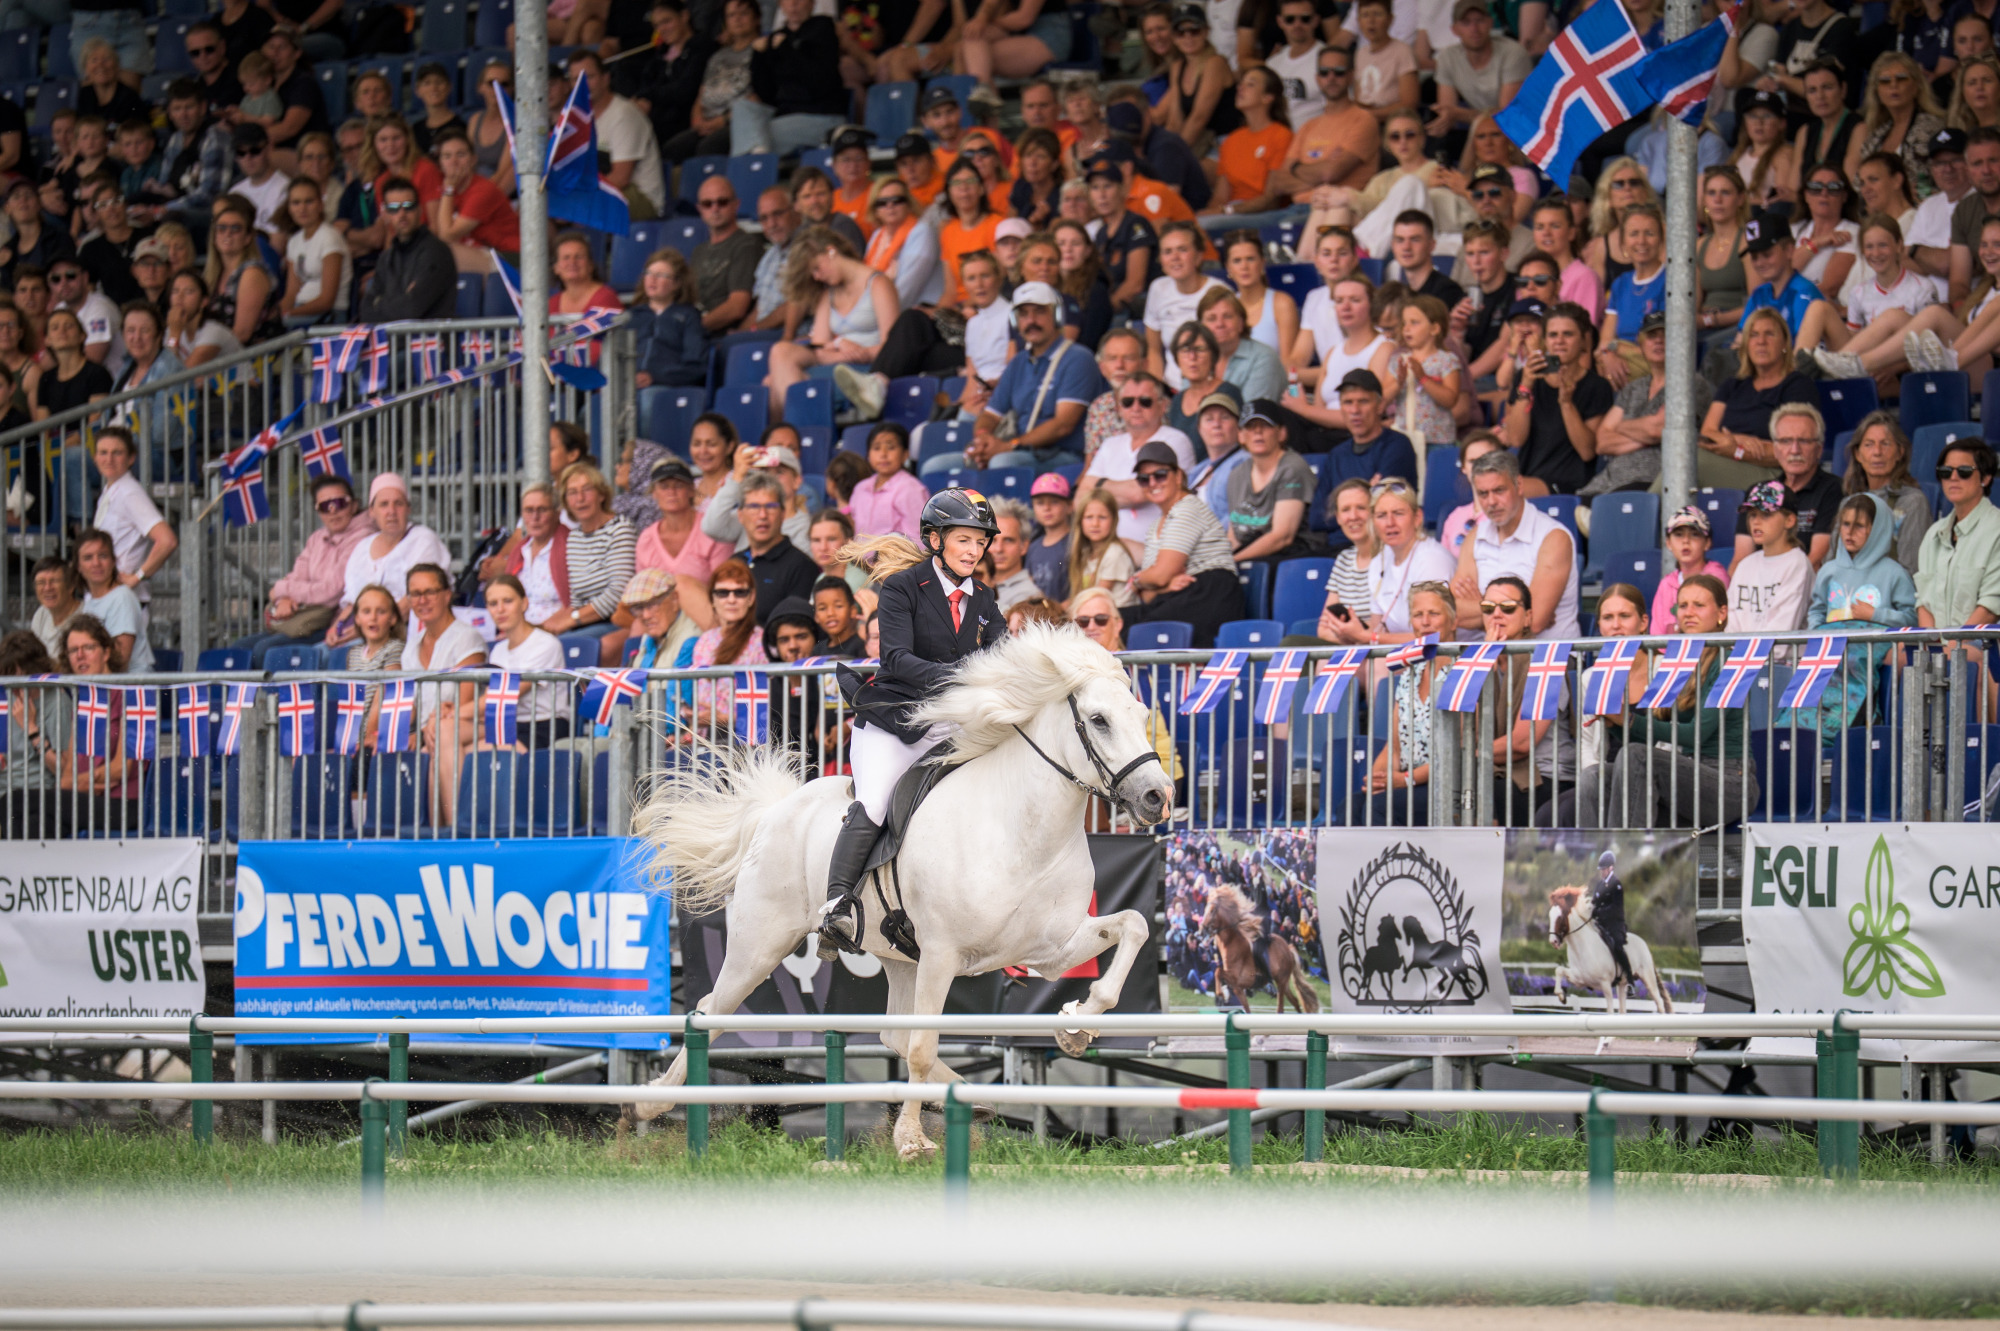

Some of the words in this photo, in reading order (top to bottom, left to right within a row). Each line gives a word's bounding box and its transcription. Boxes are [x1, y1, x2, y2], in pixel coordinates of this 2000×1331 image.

[0, 876, 146, 912] GARTENBAU
[153, 876, 191, 912] AG
[1751, 846, 1839, 908] EGLI
[88, 929, 198, 982] USTER
[294, 998, 313, 1012] und
[314, 998, 350, 1012] aktuelle
[352, 997, 418, 1014] Wochenzeitung
[418, 997, 438, 1011] rund
[438, 1000, 451, 1011] um
[452, 997, 467, 1010] das
